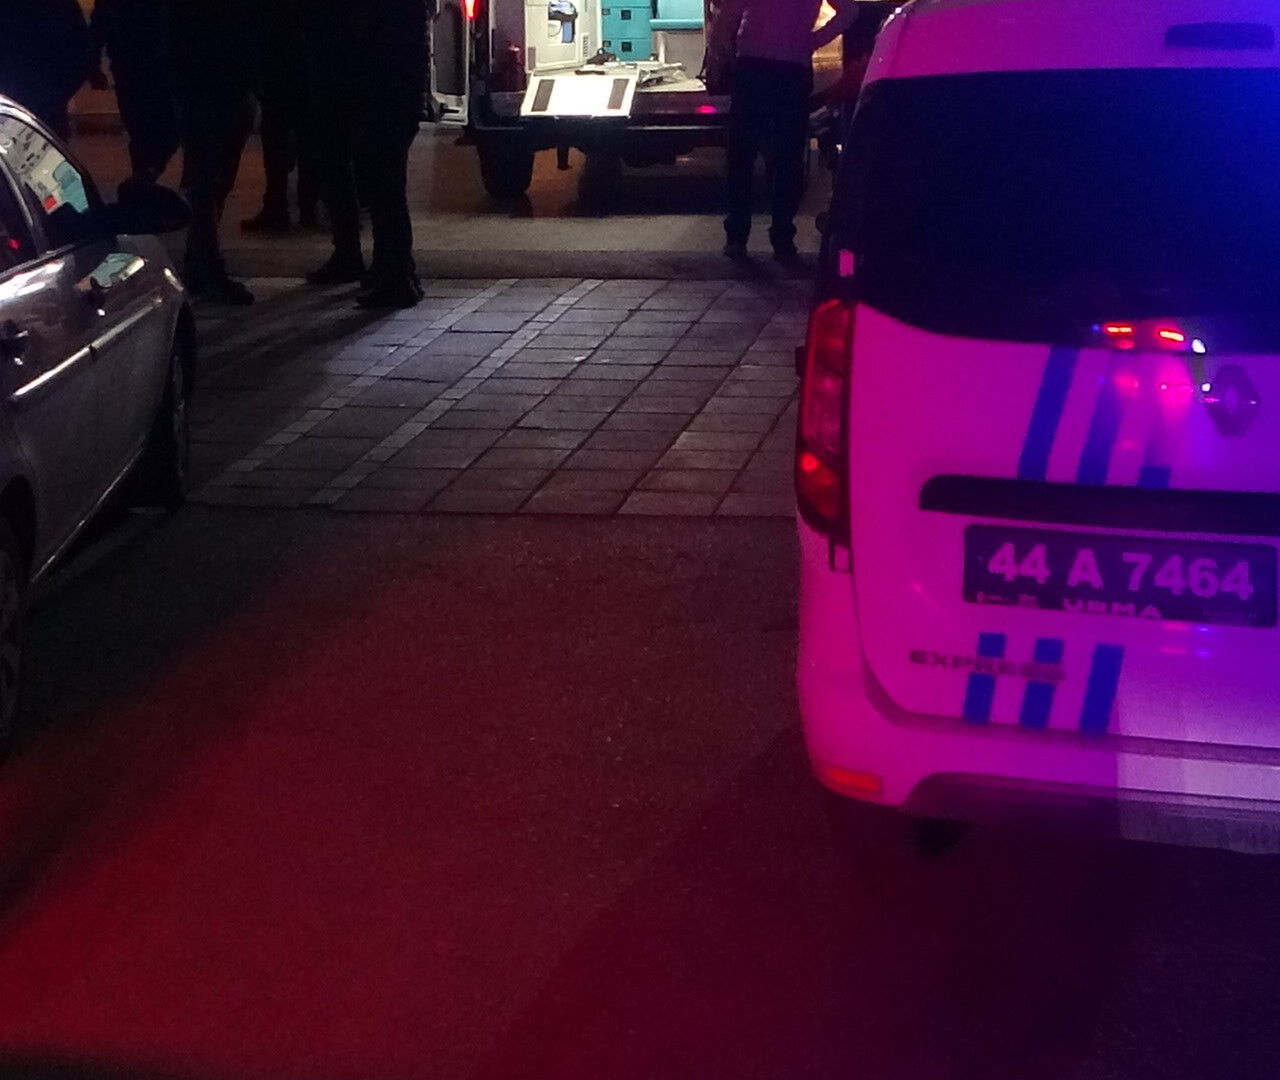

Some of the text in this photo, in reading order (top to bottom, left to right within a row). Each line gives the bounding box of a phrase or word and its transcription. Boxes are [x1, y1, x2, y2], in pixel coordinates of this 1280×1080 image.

[987, 542, 1254, 602] 44 A 7464
